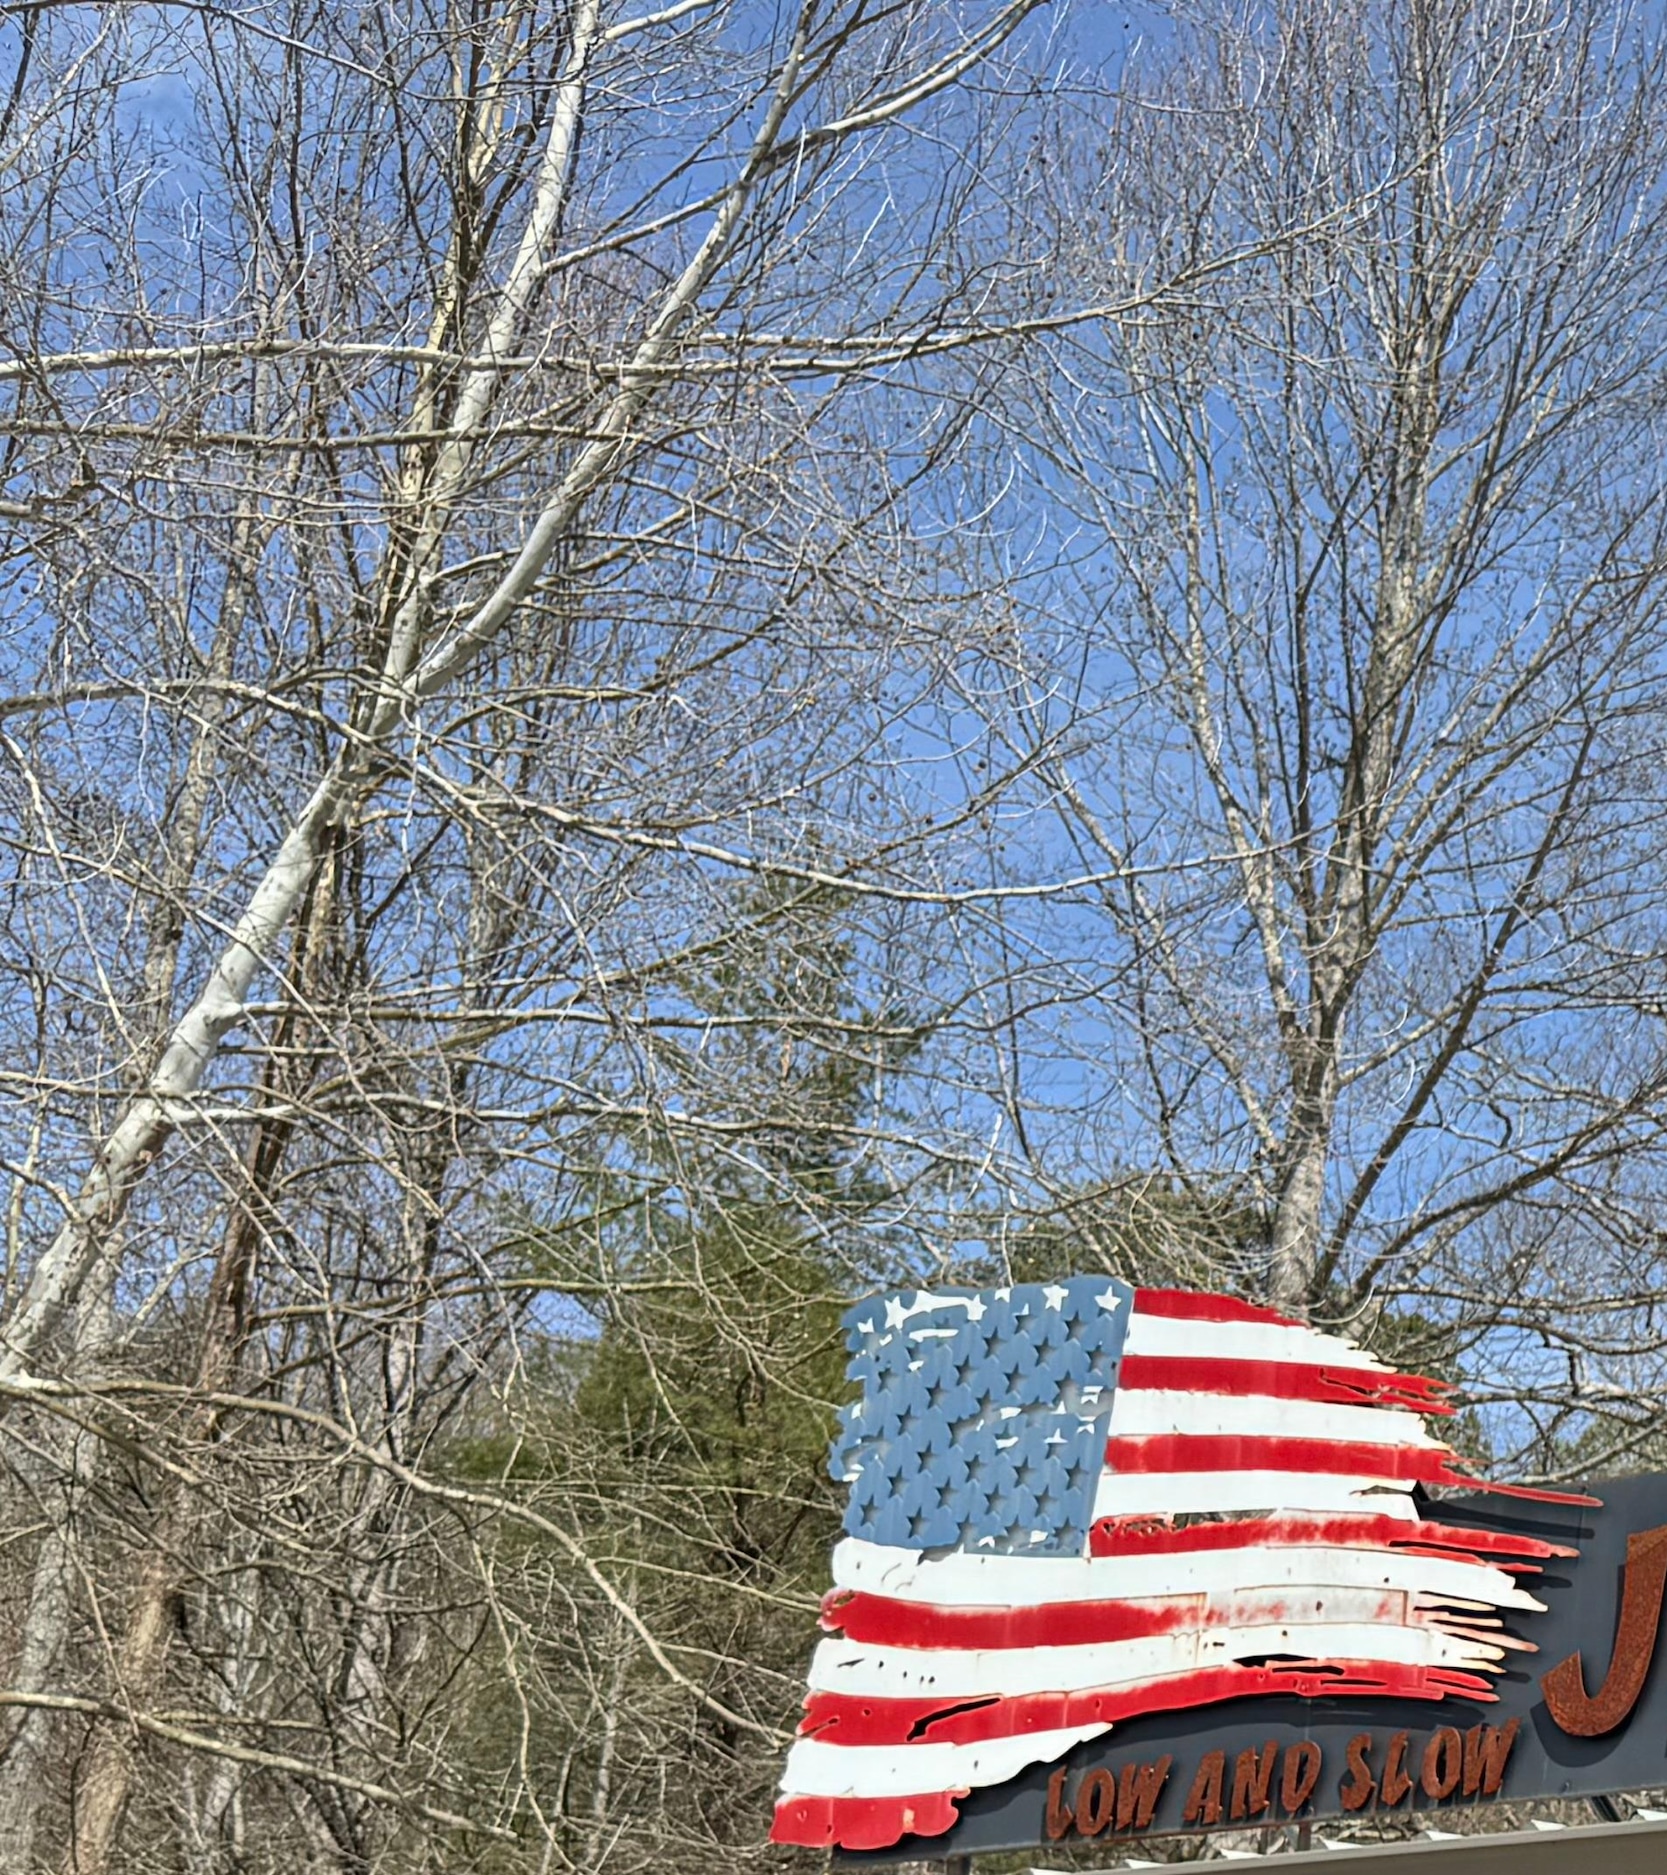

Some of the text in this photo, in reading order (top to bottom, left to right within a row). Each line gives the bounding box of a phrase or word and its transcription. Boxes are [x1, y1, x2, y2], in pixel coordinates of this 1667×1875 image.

[1046, 1716, 1522, 1840] LOW AND SLOW
